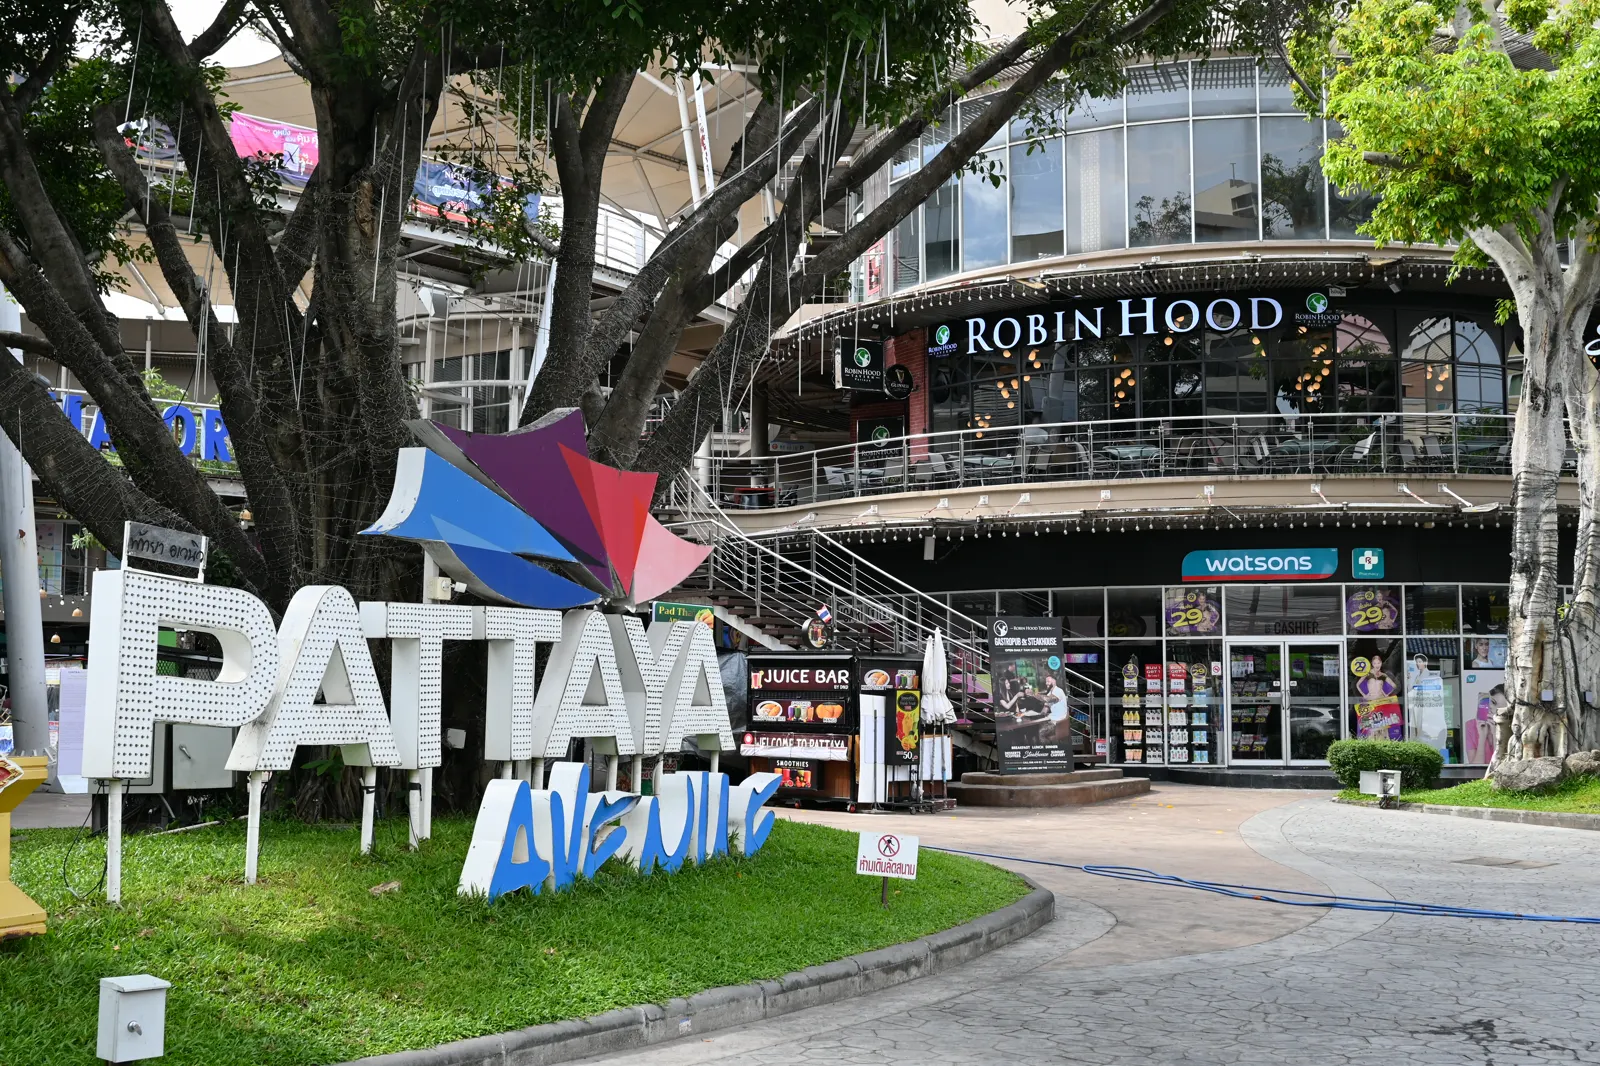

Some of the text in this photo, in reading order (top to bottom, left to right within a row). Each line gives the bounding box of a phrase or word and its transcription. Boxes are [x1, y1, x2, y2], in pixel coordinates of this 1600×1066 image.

[966, 297, 1283, 354] ROBIN HOOD
[844, 367, 881, 377] ROBIN HOOD
[1205, 555, 1312, 572] watsons
[658, 606, 675, 615] Pad
[1171, 608, 1203, 627] 29
[1351, 606, 1383, 627] 29
[1274, 621, 1319, 634] CASHIER
[1027, 637, 1057, 645] STEAKHOUSE
[83, 569, 735, 779] PATTAYA
[1354, 661, 1366, 672] 29
[764, 669, 849, 684] JUICE BAR
[776, 760, 809, 768] SMOOTHIES
[859, 855, 915, 876] ห้ามเดินลัดสนาม
